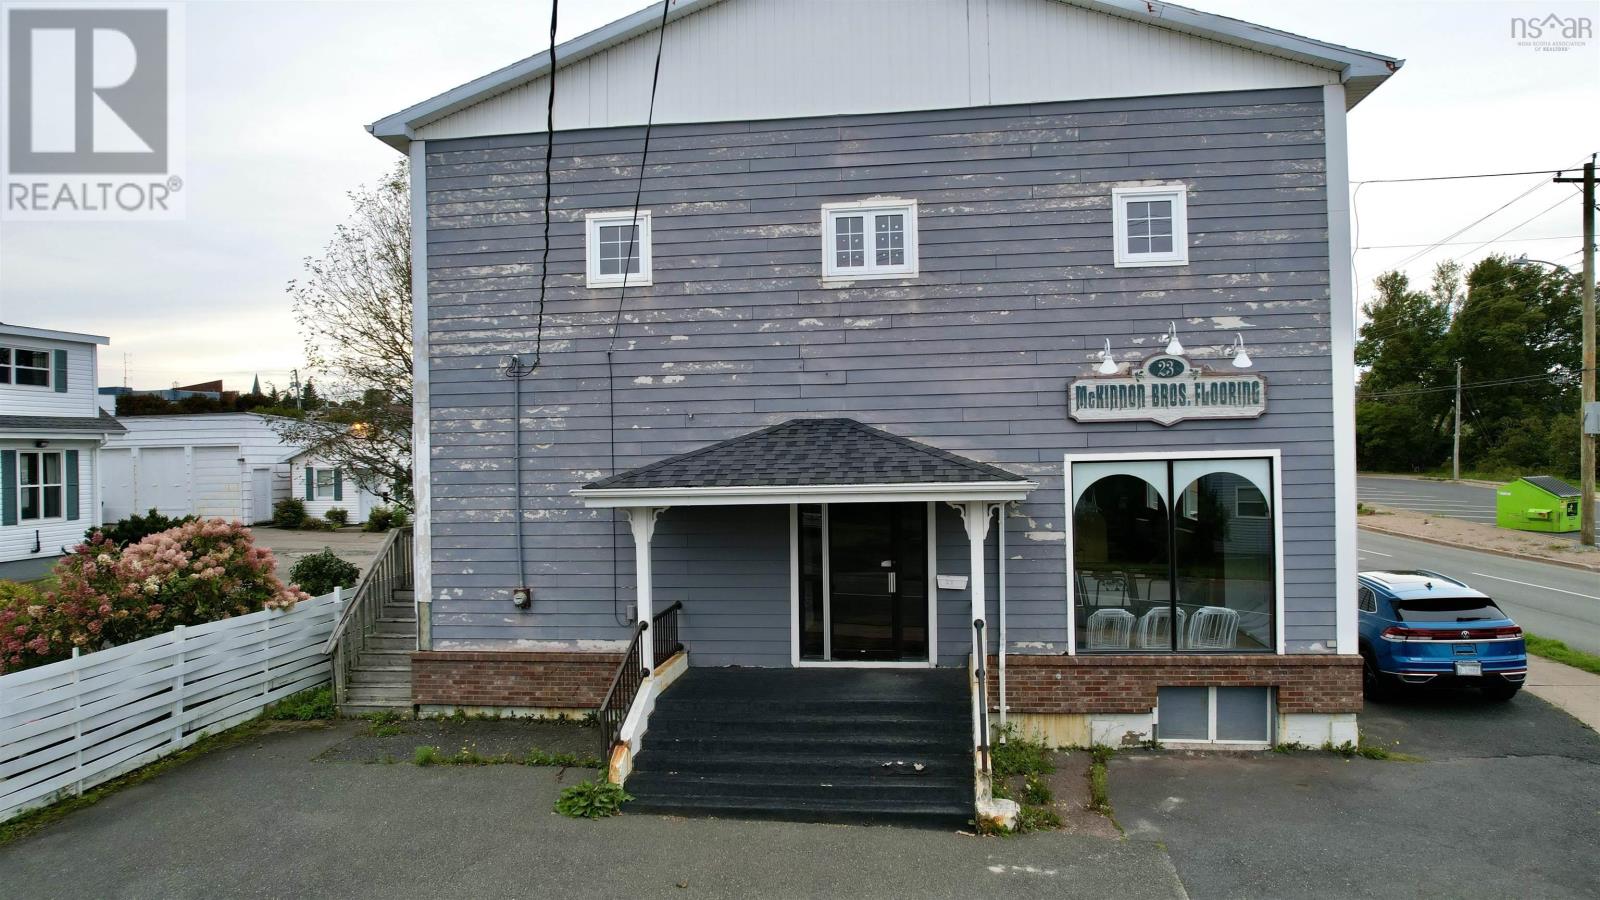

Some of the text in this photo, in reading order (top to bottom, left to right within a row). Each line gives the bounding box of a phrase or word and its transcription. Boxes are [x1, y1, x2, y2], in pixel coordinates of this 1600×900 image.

[1157, 360, 1174, 376] 23
[1152, 383, 1191, 409] BROS.
[1194, 380, 1260, 408] FLOORING
